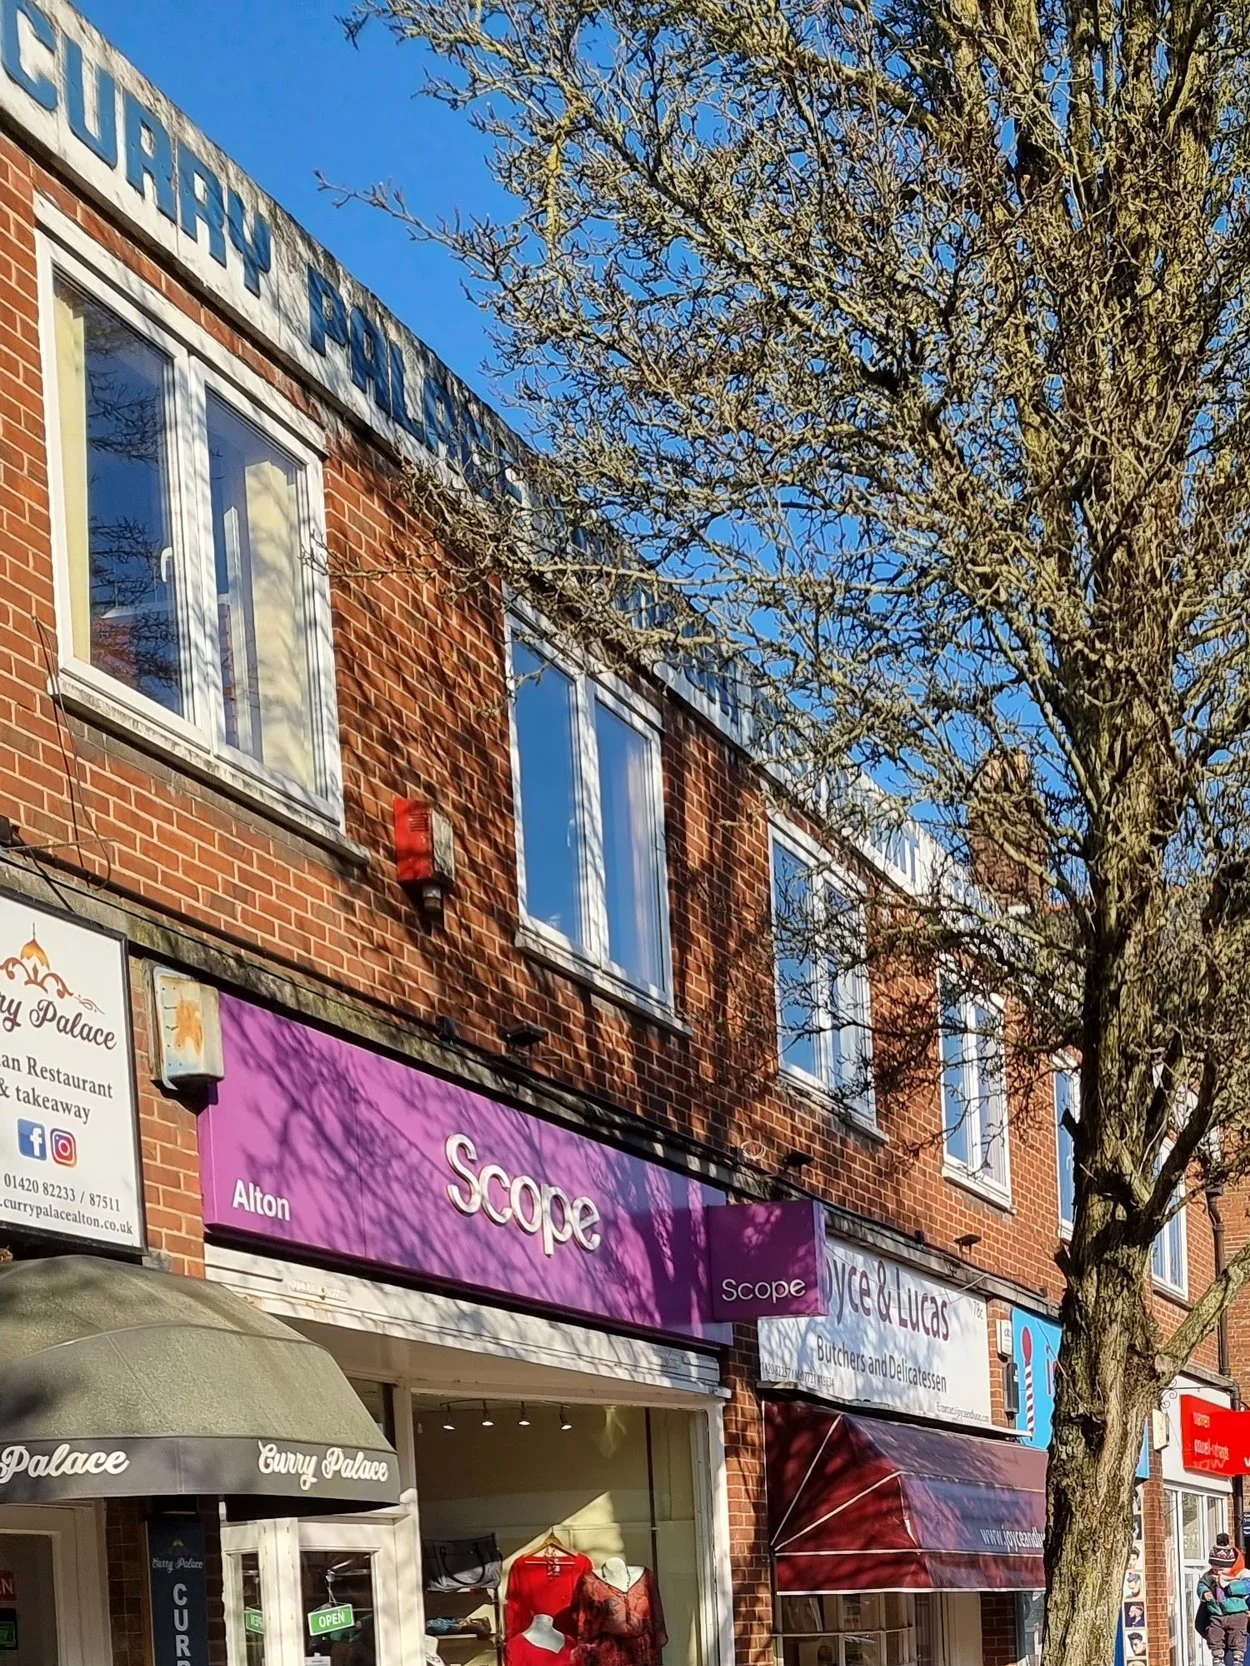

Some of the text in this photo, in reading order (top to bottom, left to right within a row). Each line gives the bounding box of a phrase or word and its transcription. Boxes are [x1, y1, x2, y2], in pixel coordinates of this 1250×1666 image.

[2, 0, 272, 298] CURRY
[29, 998, 117, 1051] Palace
[26, 1055, 114, 1099] Restaurant
[16, 1084, 91, 1124] takeaway
[4, 1173, 39, 1193] 01420
[42, 1180, 76, 1202] 82233
[89, 1192, 121, 1212] 87511
[232, 1178, 291, 1221] Alton
[445, 1132, 602, 1256] Scope
[0, 1197, 134, 1235] .currypalacealton.co.uk
[721, 1275, 806, 1304] Scope
[877, 1259, 893, 1326] &
[896, 1266, 950, 1341] Lucas
[816, 1334, 948, 1394] Butchers and Delicatessen
[0, 1443, 130, 1485] Palace
[258, 1439, 389, 1491] Curry Palace
[152, 1556, 204, 1573] Curry Palace
[318, 1611, 345, 1628] OPEN
